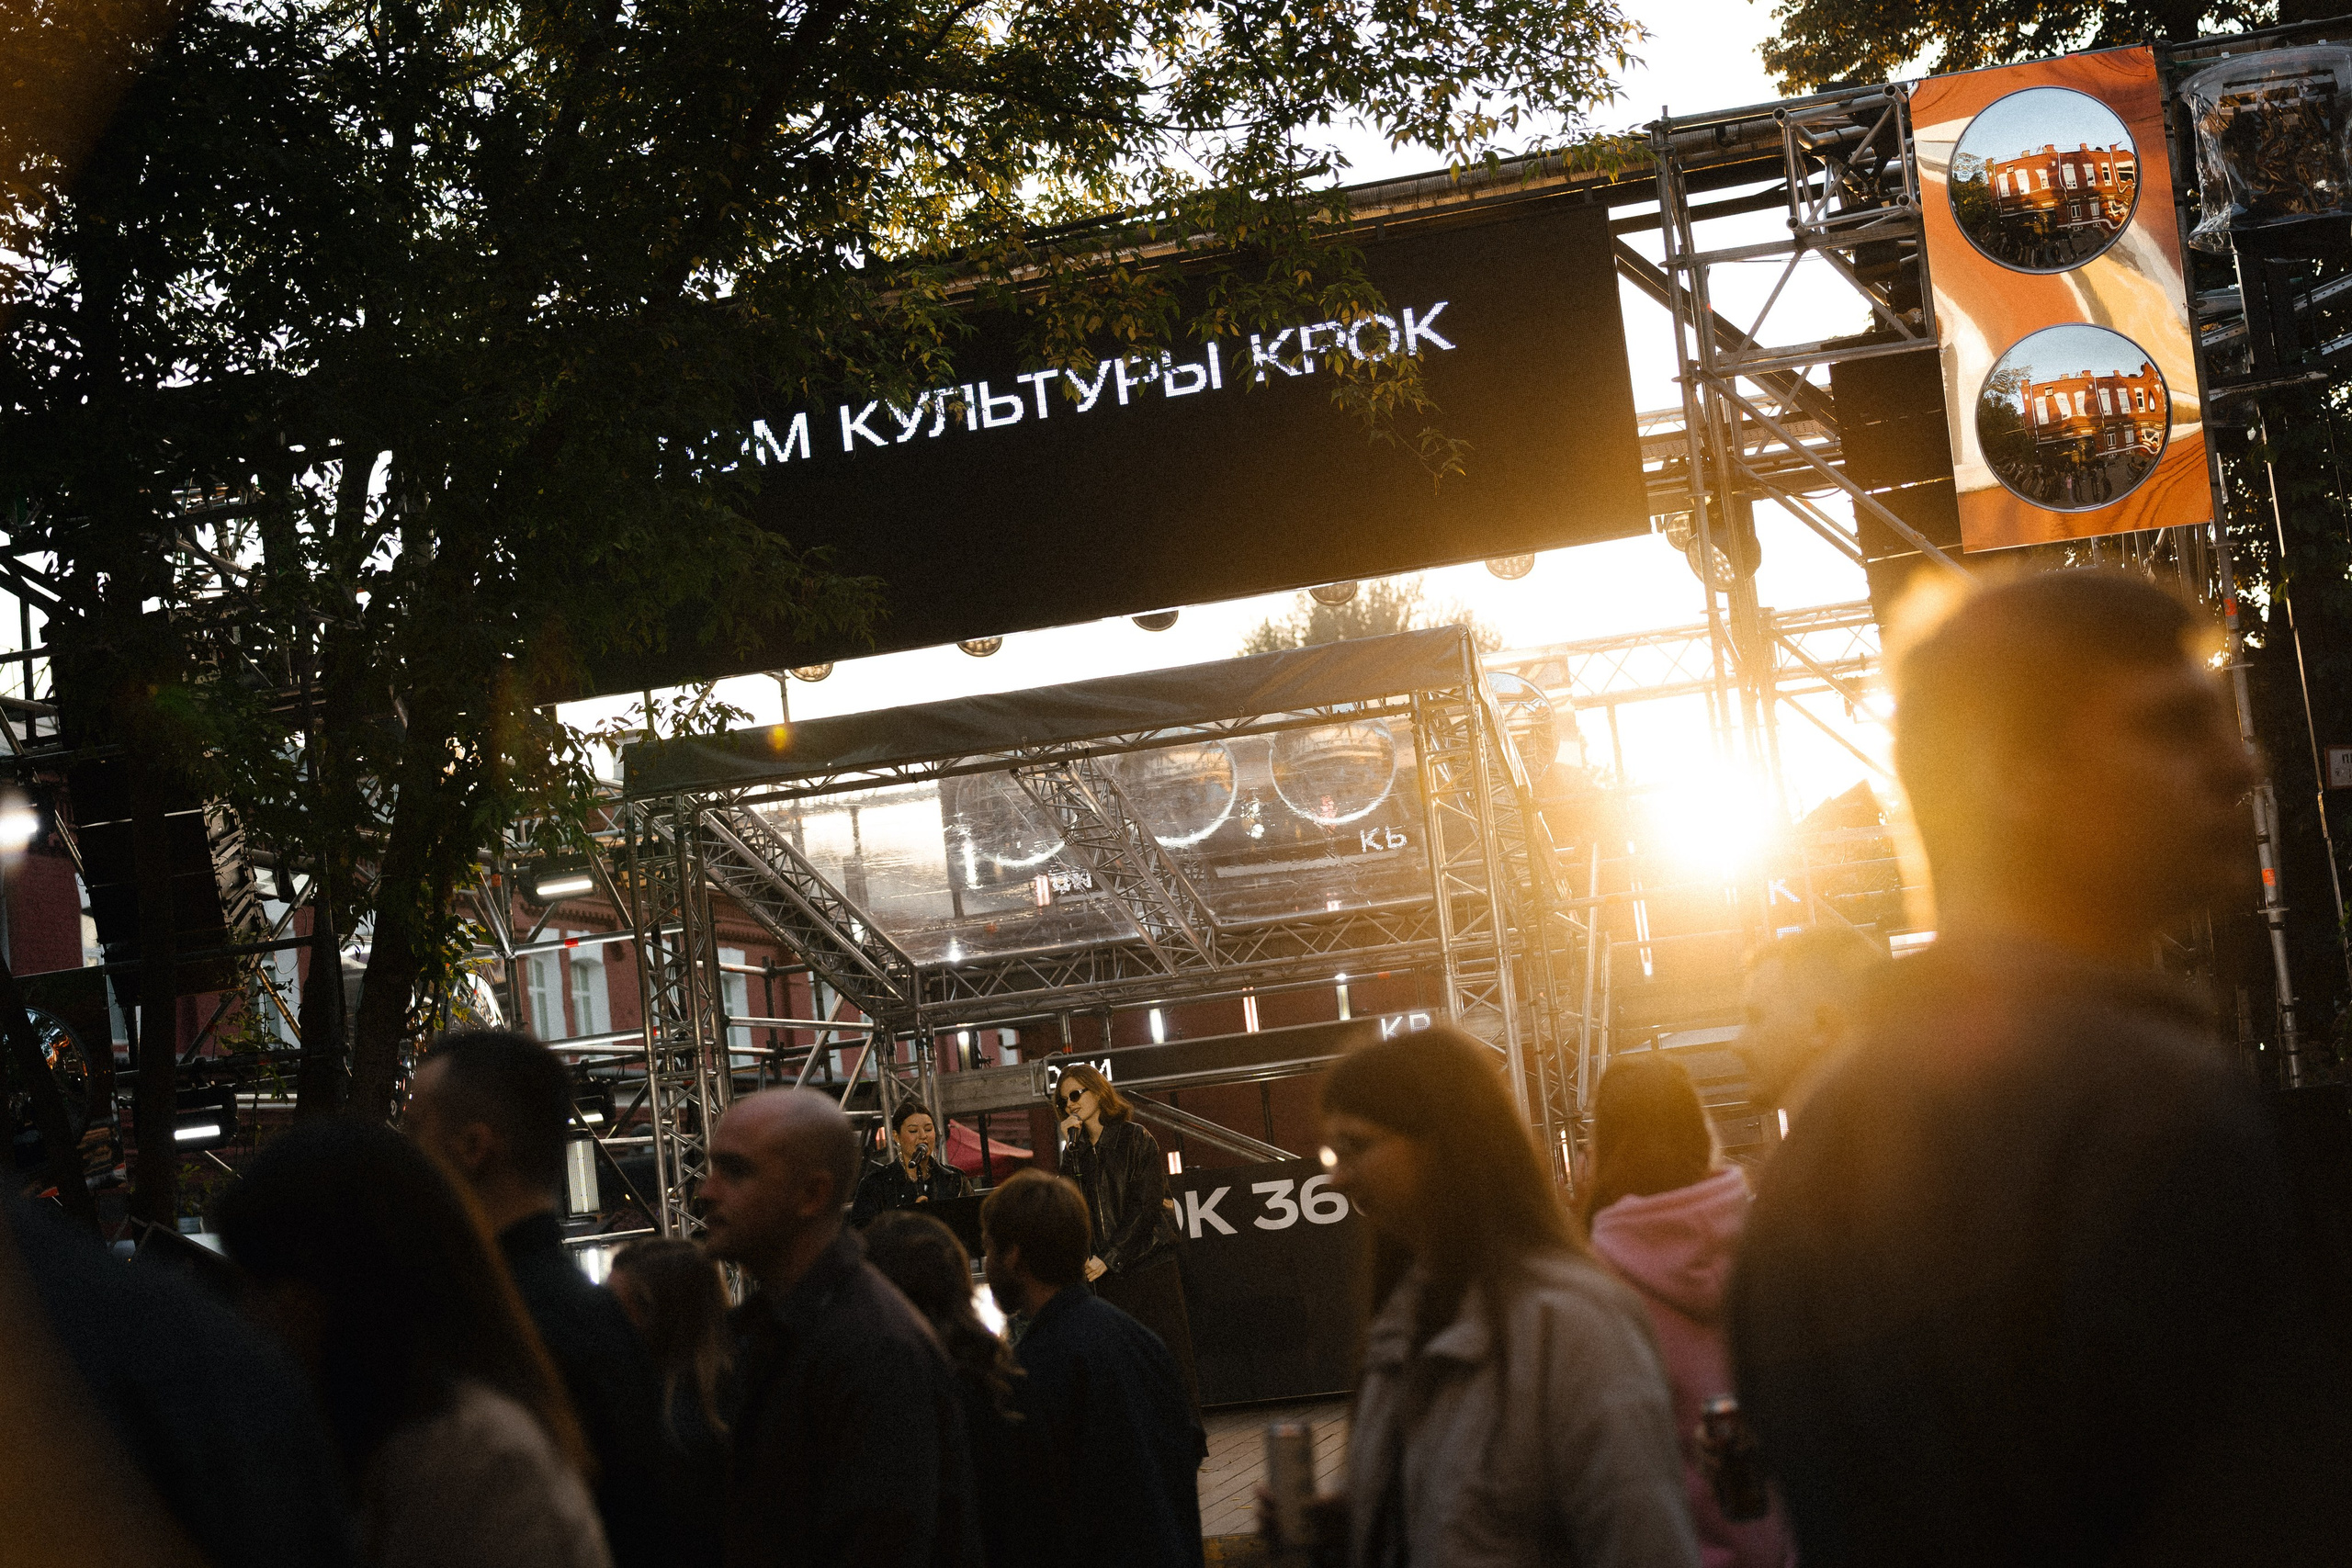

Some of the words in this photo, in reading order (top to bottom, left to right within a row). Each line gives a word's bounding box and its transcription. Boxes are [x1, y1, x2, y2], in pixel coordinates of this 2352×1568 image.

[840, 342, 1223, 452] КУЛЬТУРЫ
[1250, 301, 1457, 382] КРОК
[1172, 1185, 1238, 1239] К
[1251, 1173, 1371, 1231] 36
